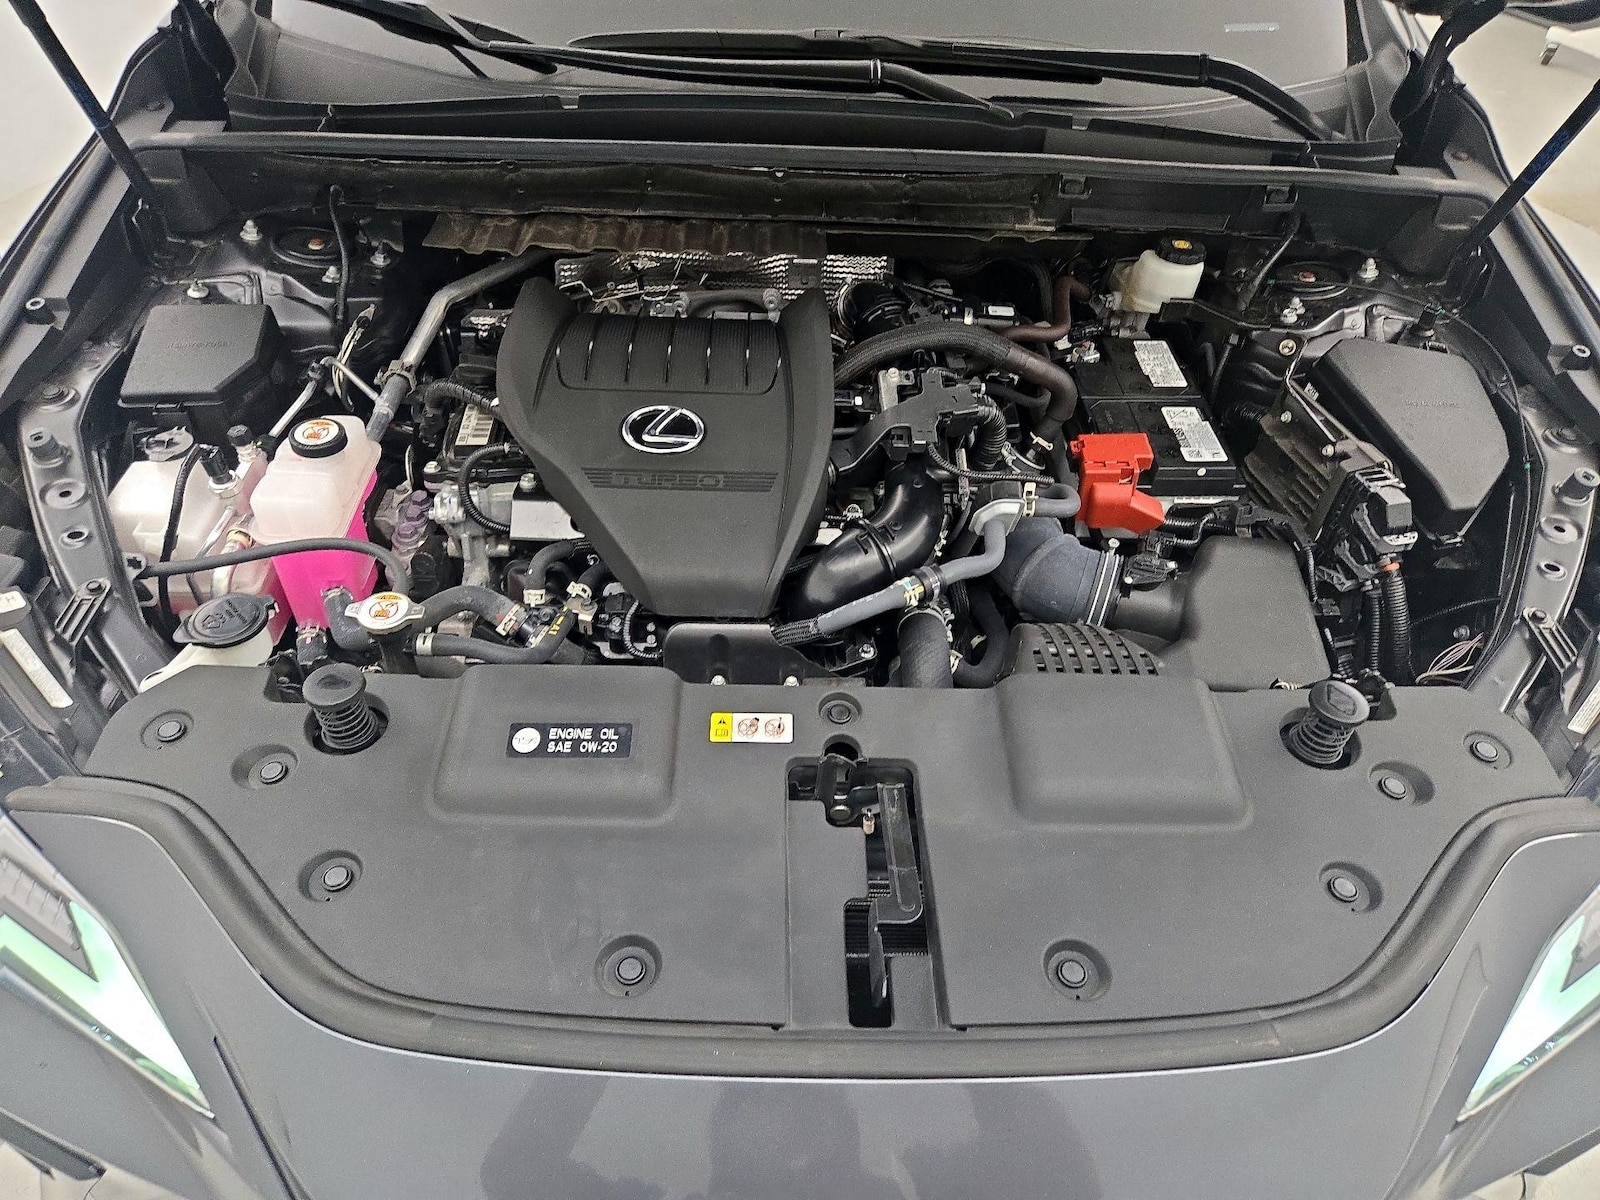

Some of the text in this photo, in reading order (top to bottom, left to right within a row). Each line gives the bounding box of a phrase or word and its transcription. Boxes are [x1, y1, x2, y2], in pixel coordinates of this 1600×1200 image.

[615, 472, 724, 489] TURBO
[548, 727, 620, 740] ENGINE OIL
[546, 741, 618, 753] SAE 0W-20
